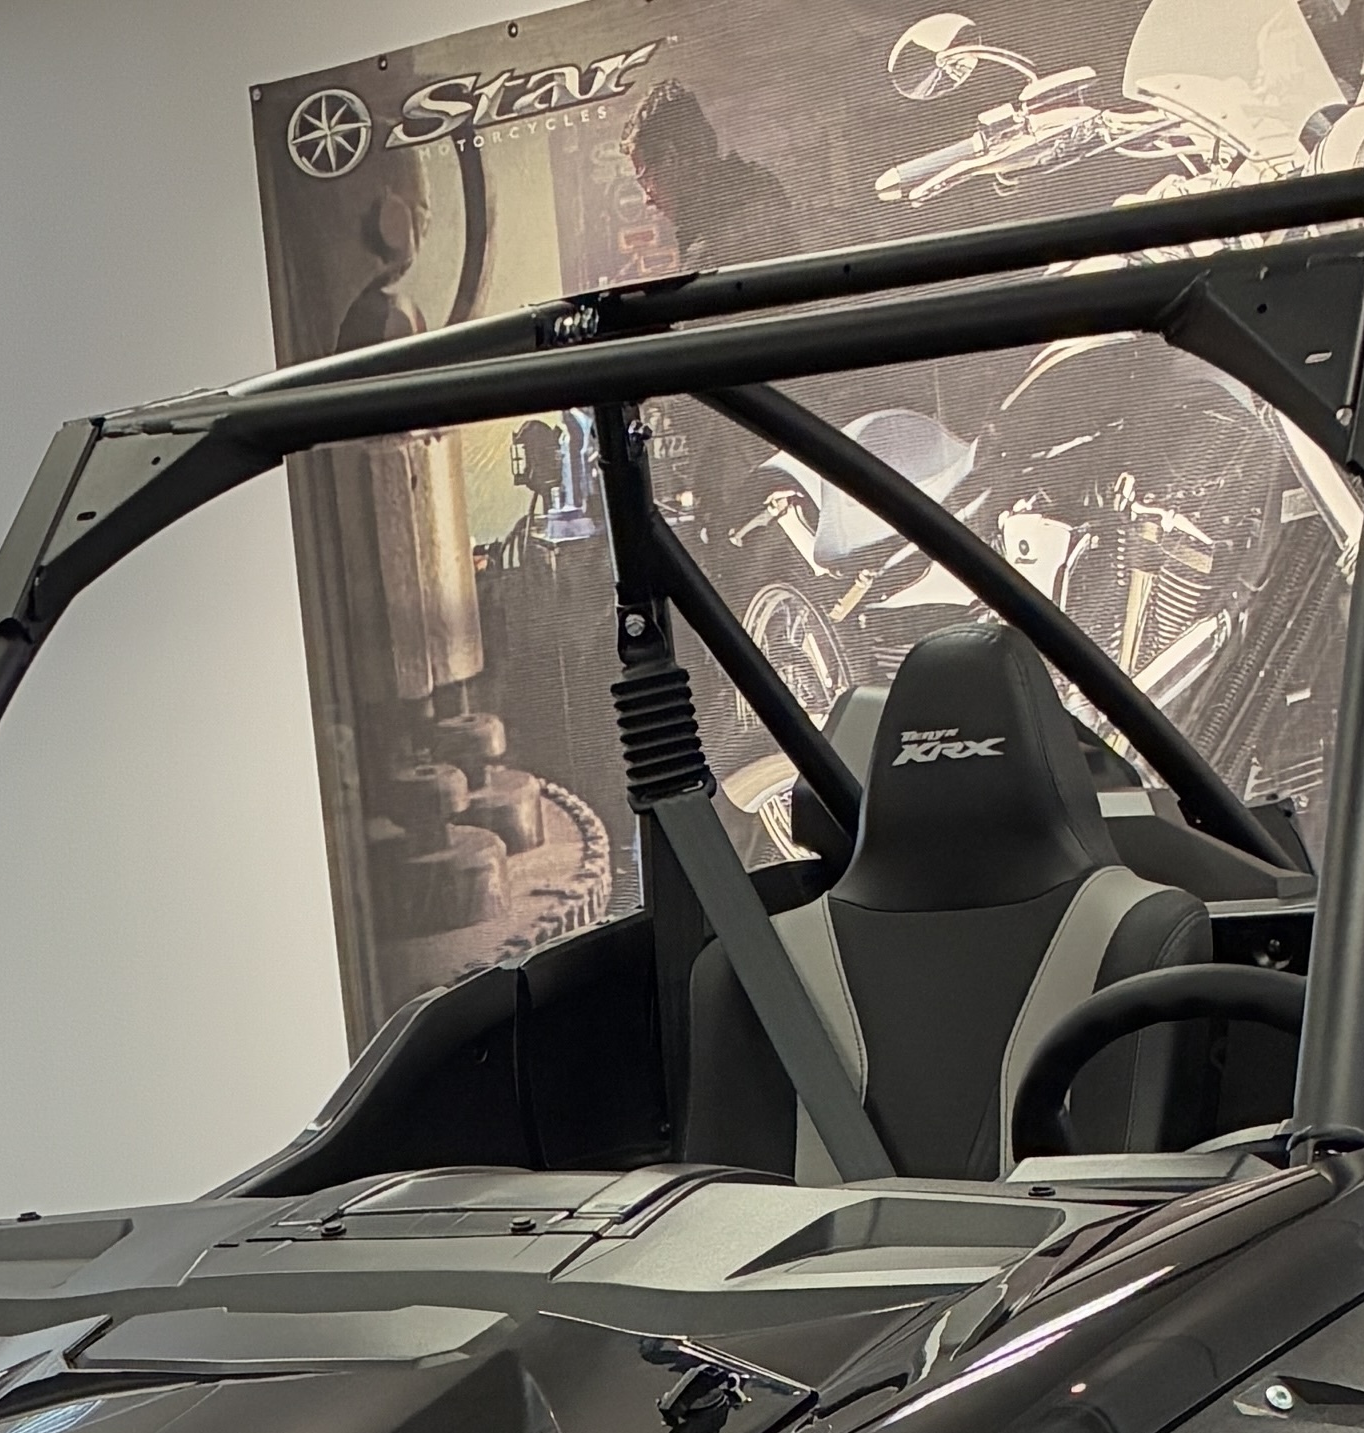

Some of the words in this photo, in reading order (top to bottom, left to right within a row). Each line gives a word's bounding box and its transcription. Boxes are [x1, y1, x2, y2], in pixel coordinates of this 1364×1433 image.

[385, 39, 663, 148] Star
[418, 106, 608, 158] MOTORCYCLES
[892, 737, 1006, 766] KRX
